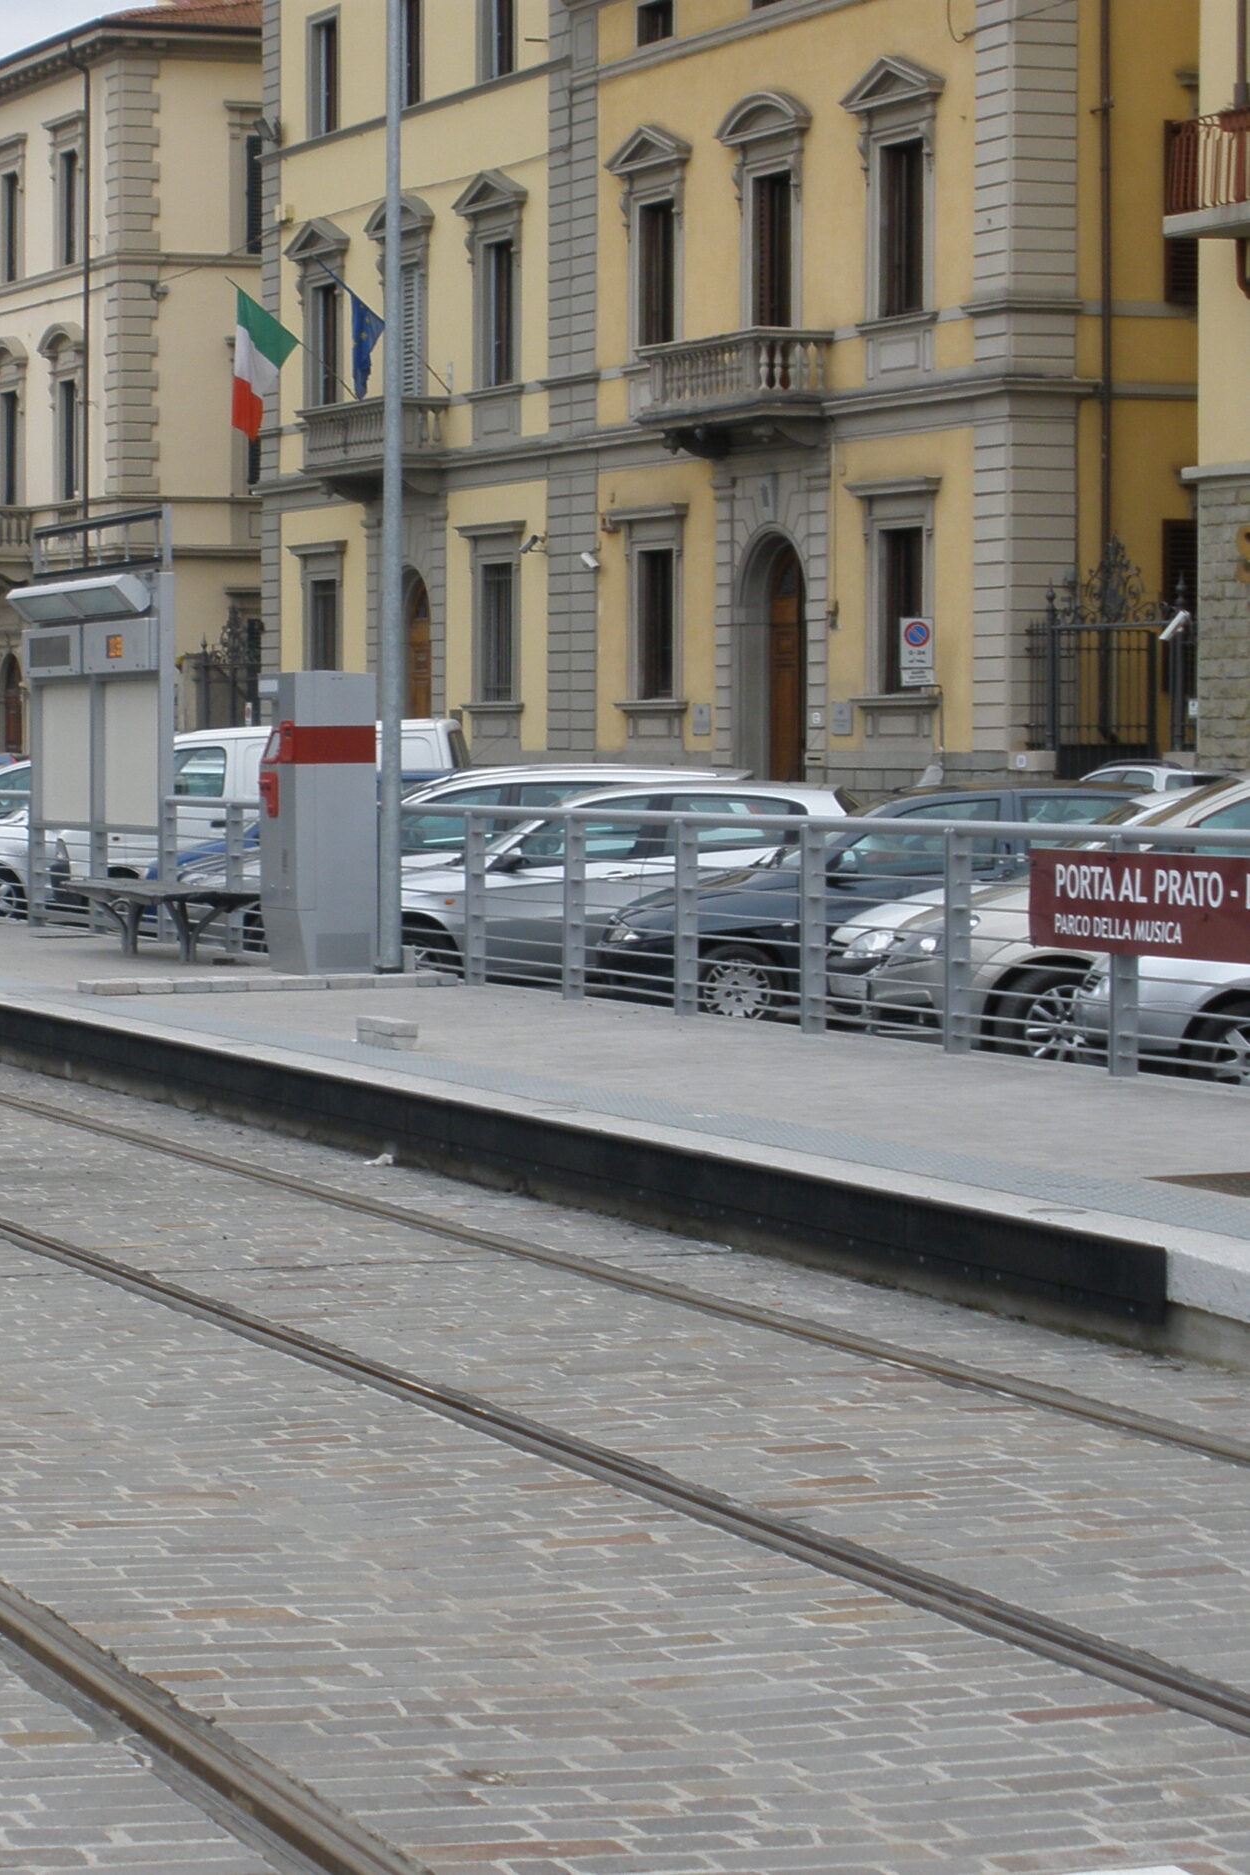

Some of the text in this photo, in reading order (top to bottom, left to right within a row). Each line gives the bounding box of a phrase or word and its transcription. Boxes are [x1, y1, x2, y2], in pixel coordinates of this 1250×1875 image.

[1055, 863, 1115, 901] PORTA
[1118, 867, 1148, 903] AL
[1154, 869, 1224, 908] PRATO
[1054, 913, 1182, 944] PARCO DELLA MUSICA
